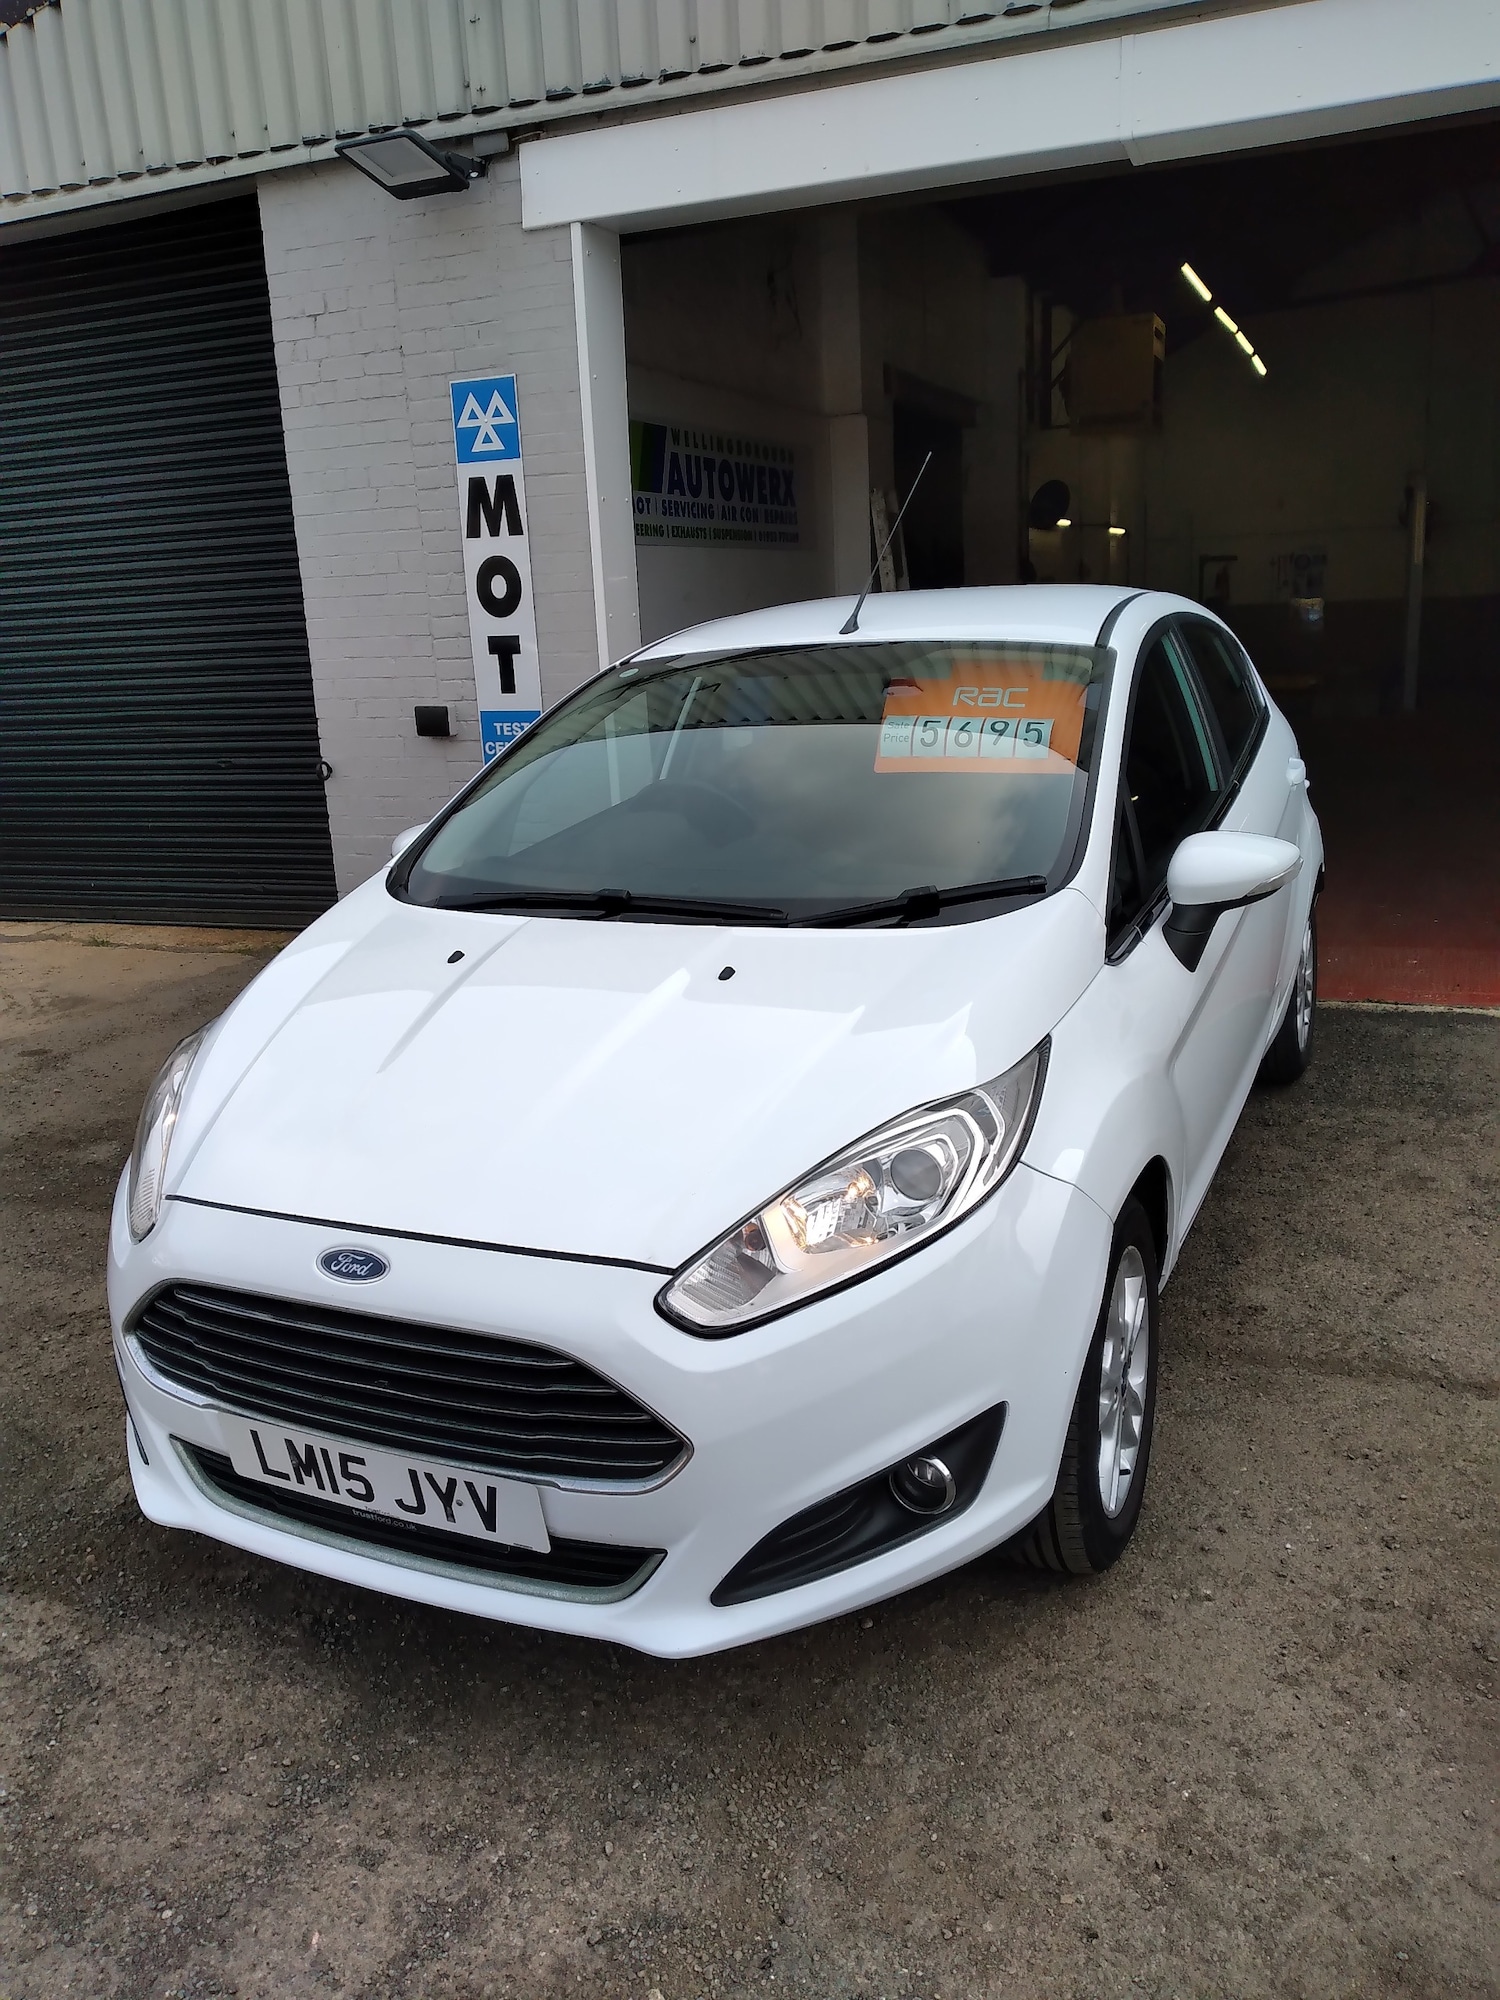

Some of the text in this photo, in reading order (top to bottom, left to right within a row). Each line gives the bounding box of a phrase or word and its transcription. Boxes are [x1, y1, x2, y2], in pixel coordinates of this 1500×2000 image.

[670, 427, 794, 464] WELLINGBOROUGH
[667, 451, 796, 507] AUTOWERX
[633, 496, 651, 515] OT
[661, 498, 714, 520] SERVICING
[721, 505, 738, 522] AIR
[740, 507, 759, 524] CON
[635, 523, 664, 537] EERING
[671, 525, 707, 540] EXHAUSTS
[712, 528, 752, 542] SUSPENSION
[466, 474, 524, 694] MOT
[883, 733, 910, 743] Price
[887, 721, 910, 730] Sale
[920, 720, 1045, 748] 5695
[330, 1252, 374, 1276] Ford
[249, 1428, 498, 1534] LM15 JYV
[351, 1508, 418, 1531] trustford.co.uk
